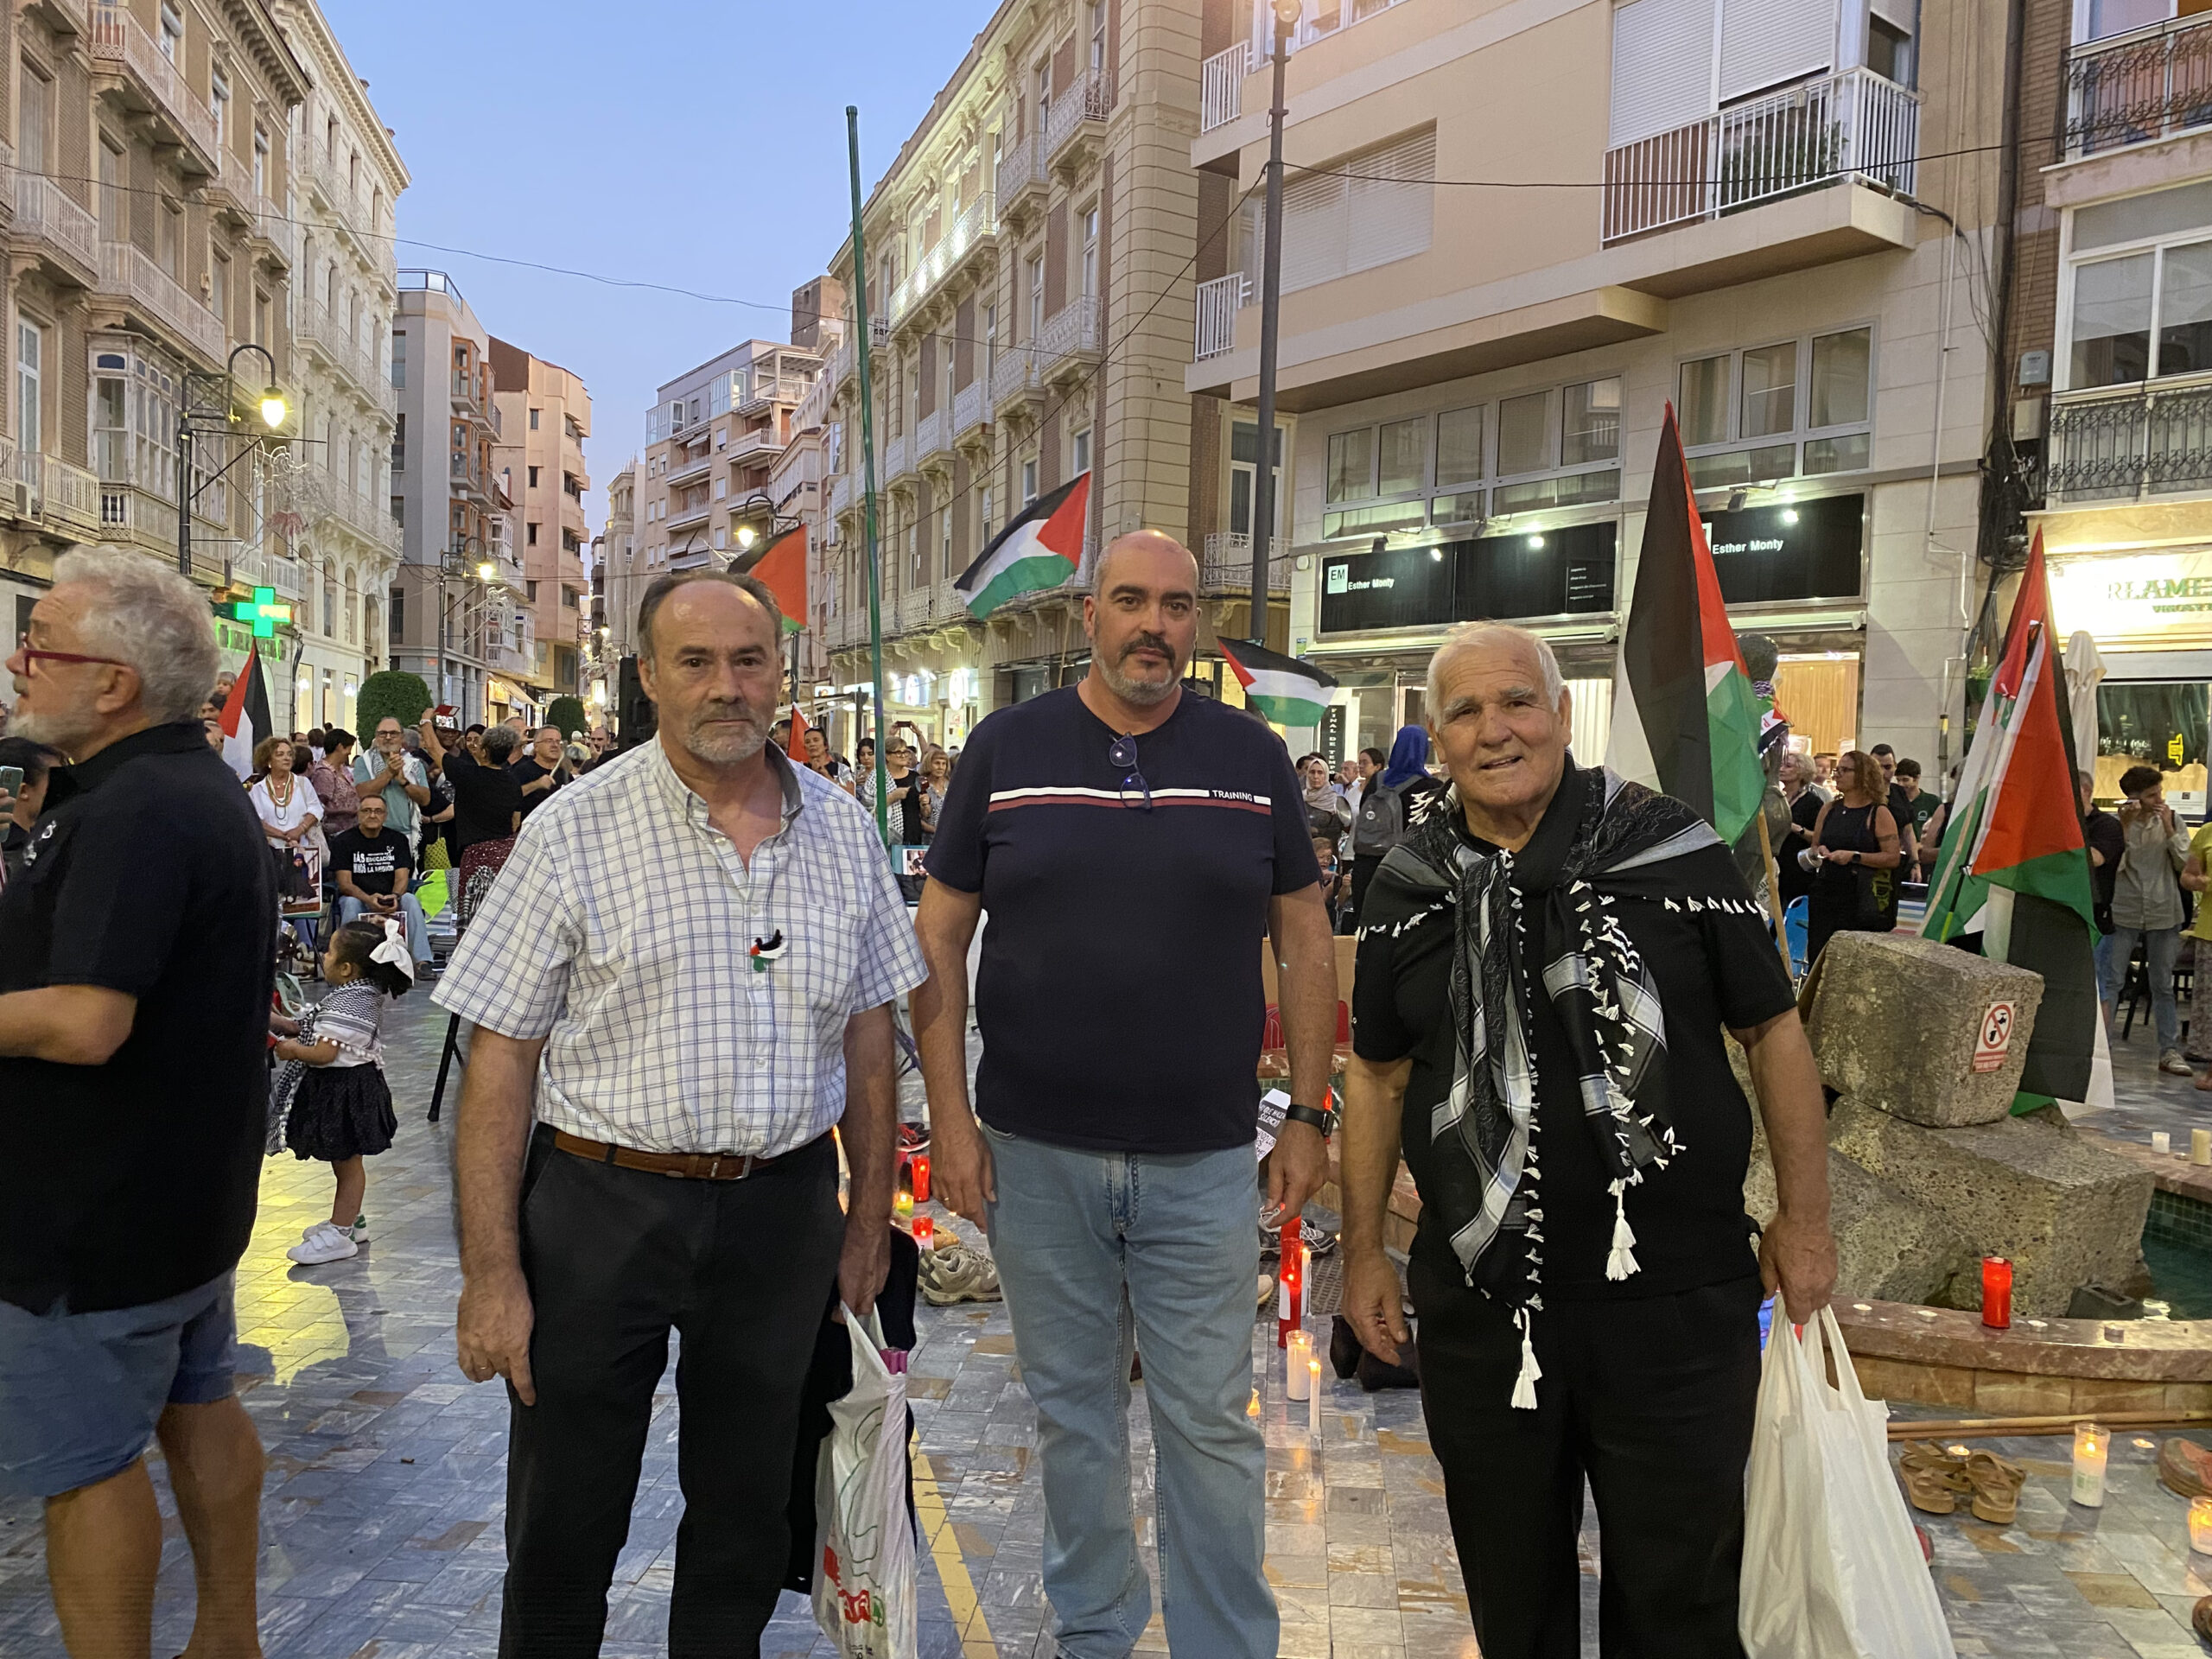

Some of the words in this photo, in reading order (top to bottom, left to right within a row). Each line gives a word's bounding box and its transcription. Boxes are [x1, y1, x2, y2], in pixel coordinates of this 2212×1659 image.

[1713, 543, 1747, 555] Esther
[1750, 539, 1784, 551] Monty
[1331, 569, 1345, 581] EM
[1348, 581, 1370, 591] Esther
[1371, 577, 1395, 588] Monty
[1211, 790, 1253, 802] TRAINING
